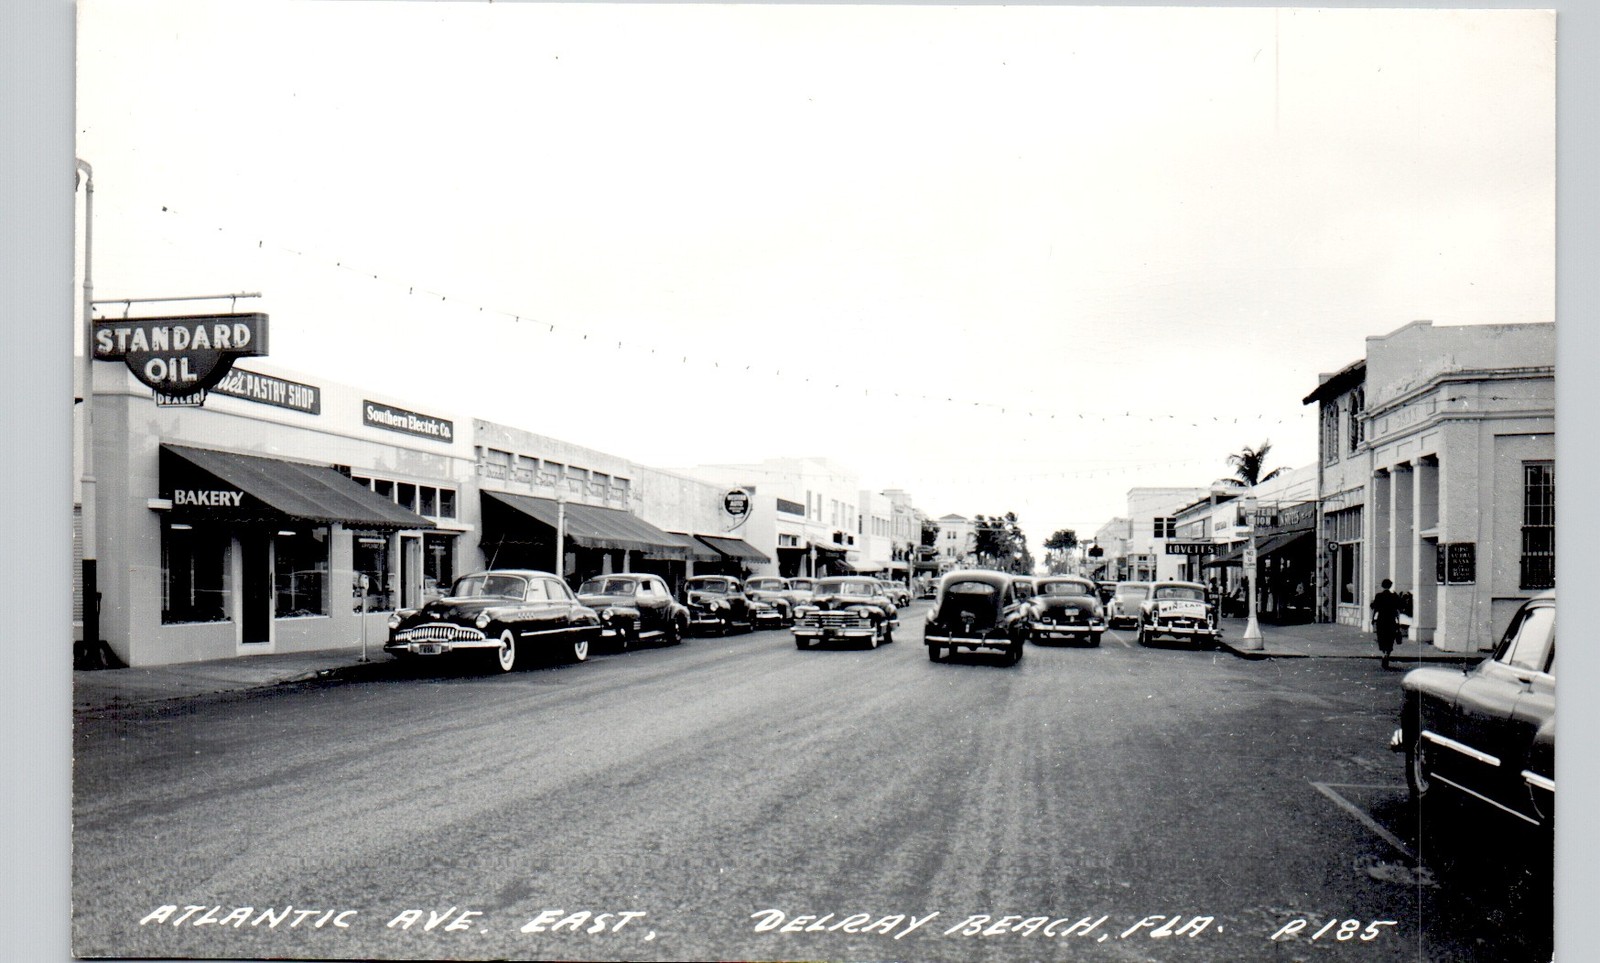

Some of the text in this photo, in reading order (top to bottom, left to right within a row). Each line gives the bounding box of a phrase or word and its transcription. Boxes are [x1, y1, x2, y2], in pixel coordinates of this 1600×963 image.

[96, 323, 251, 354] STANDARD
[144, 357, 198, 383] OIL
[158, 392, 201, 404] DEALER
[246, 374, 286, 404] PASTRY
[288, 384, 314, 410] SHOP
[366, 405, 451, 438] Southern Electric Co.
[174, 489, 244, 507] BAKERY
[1240, 508, 1277, 516] WTERN
